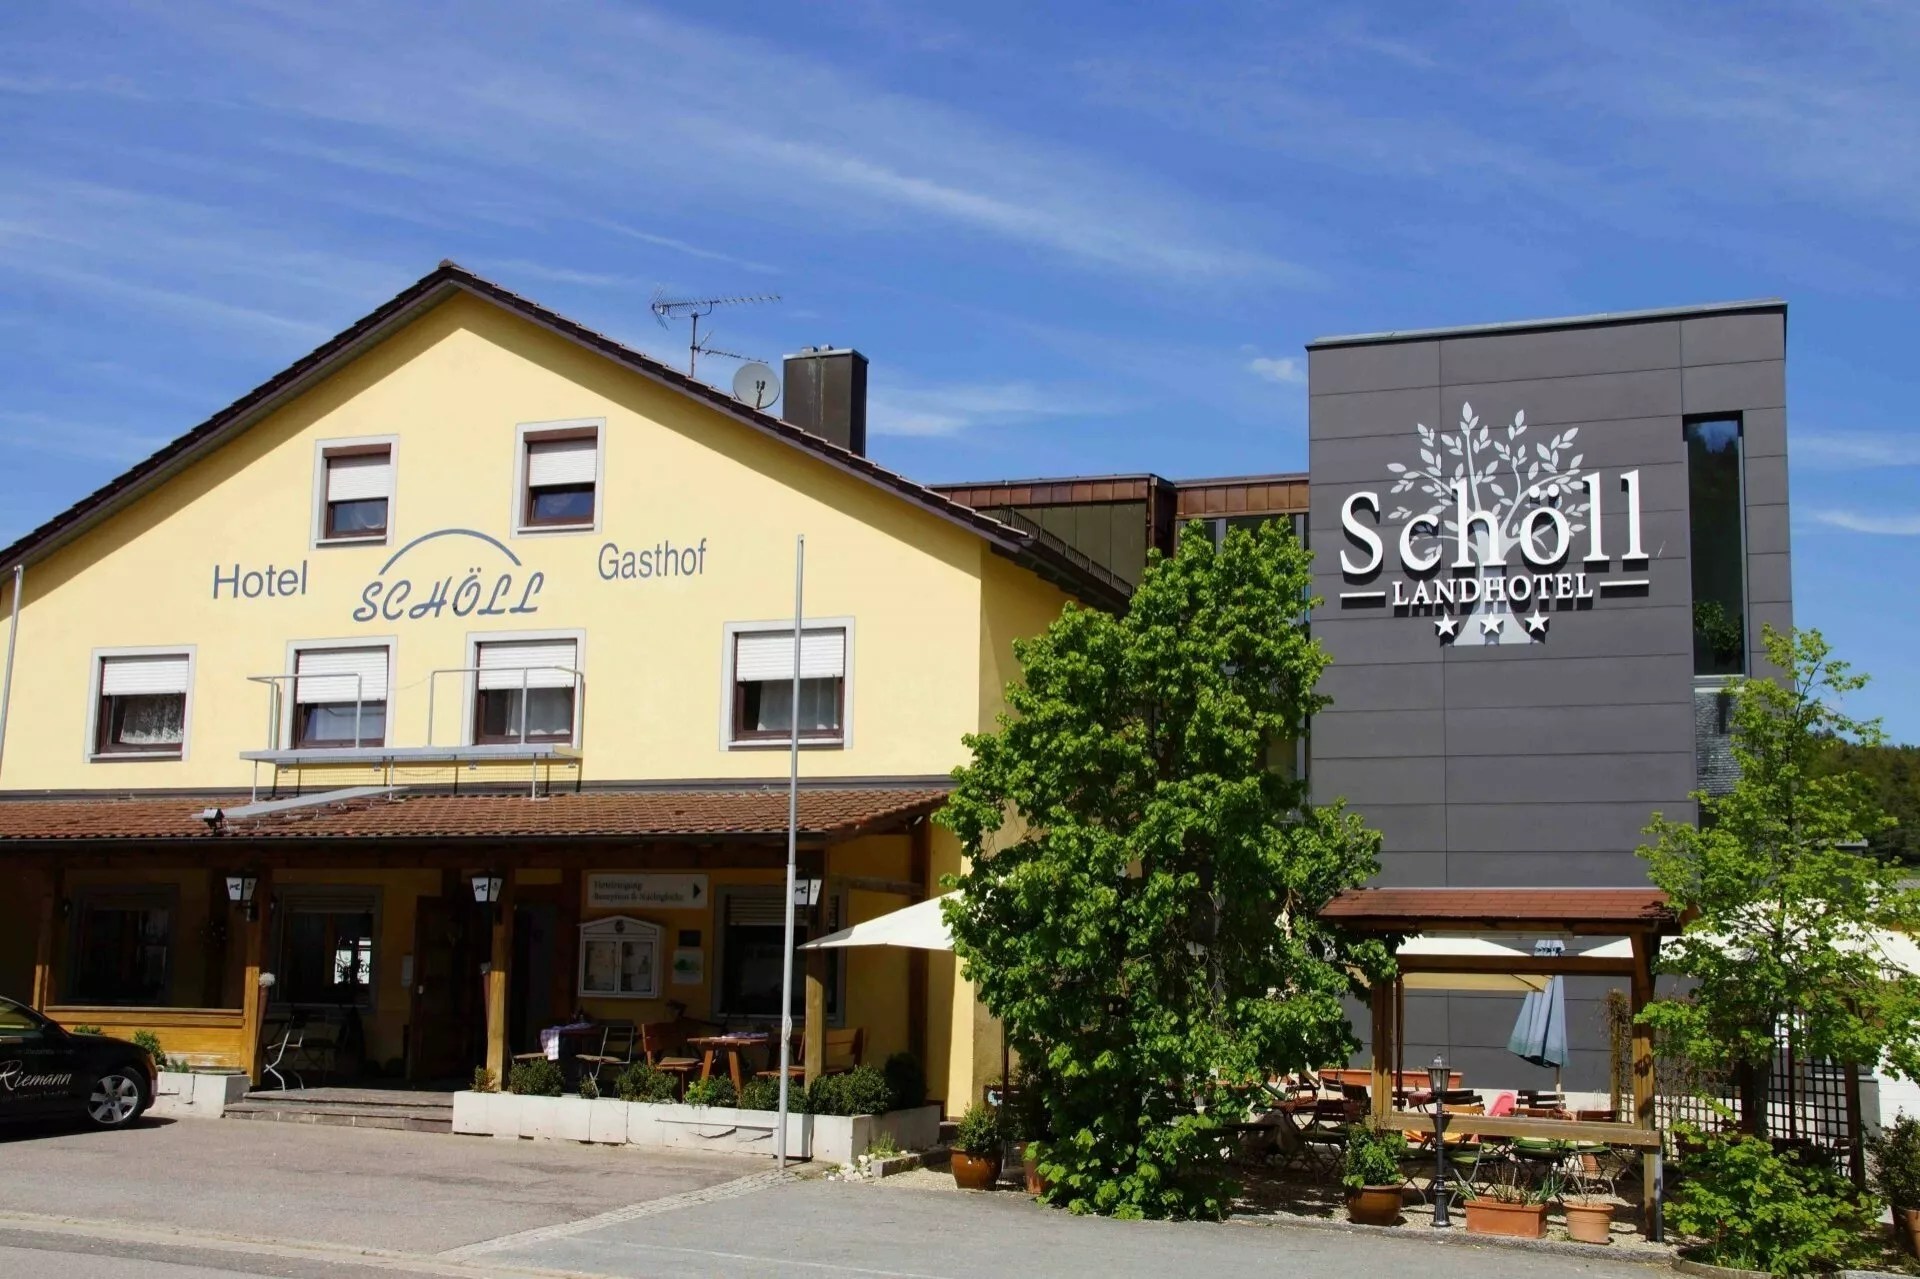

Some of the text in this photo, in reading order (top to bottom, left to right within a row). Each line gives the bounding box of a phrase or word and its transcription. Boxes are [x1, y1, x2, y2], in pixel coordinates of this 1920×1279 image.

[1339, 468, 1650, 576] Schöll
[213, 560, 308, 600] Hotel
[598, 538, 707, 581] Gasthof
[352, 566, 545, 623] SCHÖLL
[1392, 572, 1594, 606] LANDHOTEL
[0, 1059, 72, 1092] Riemann
